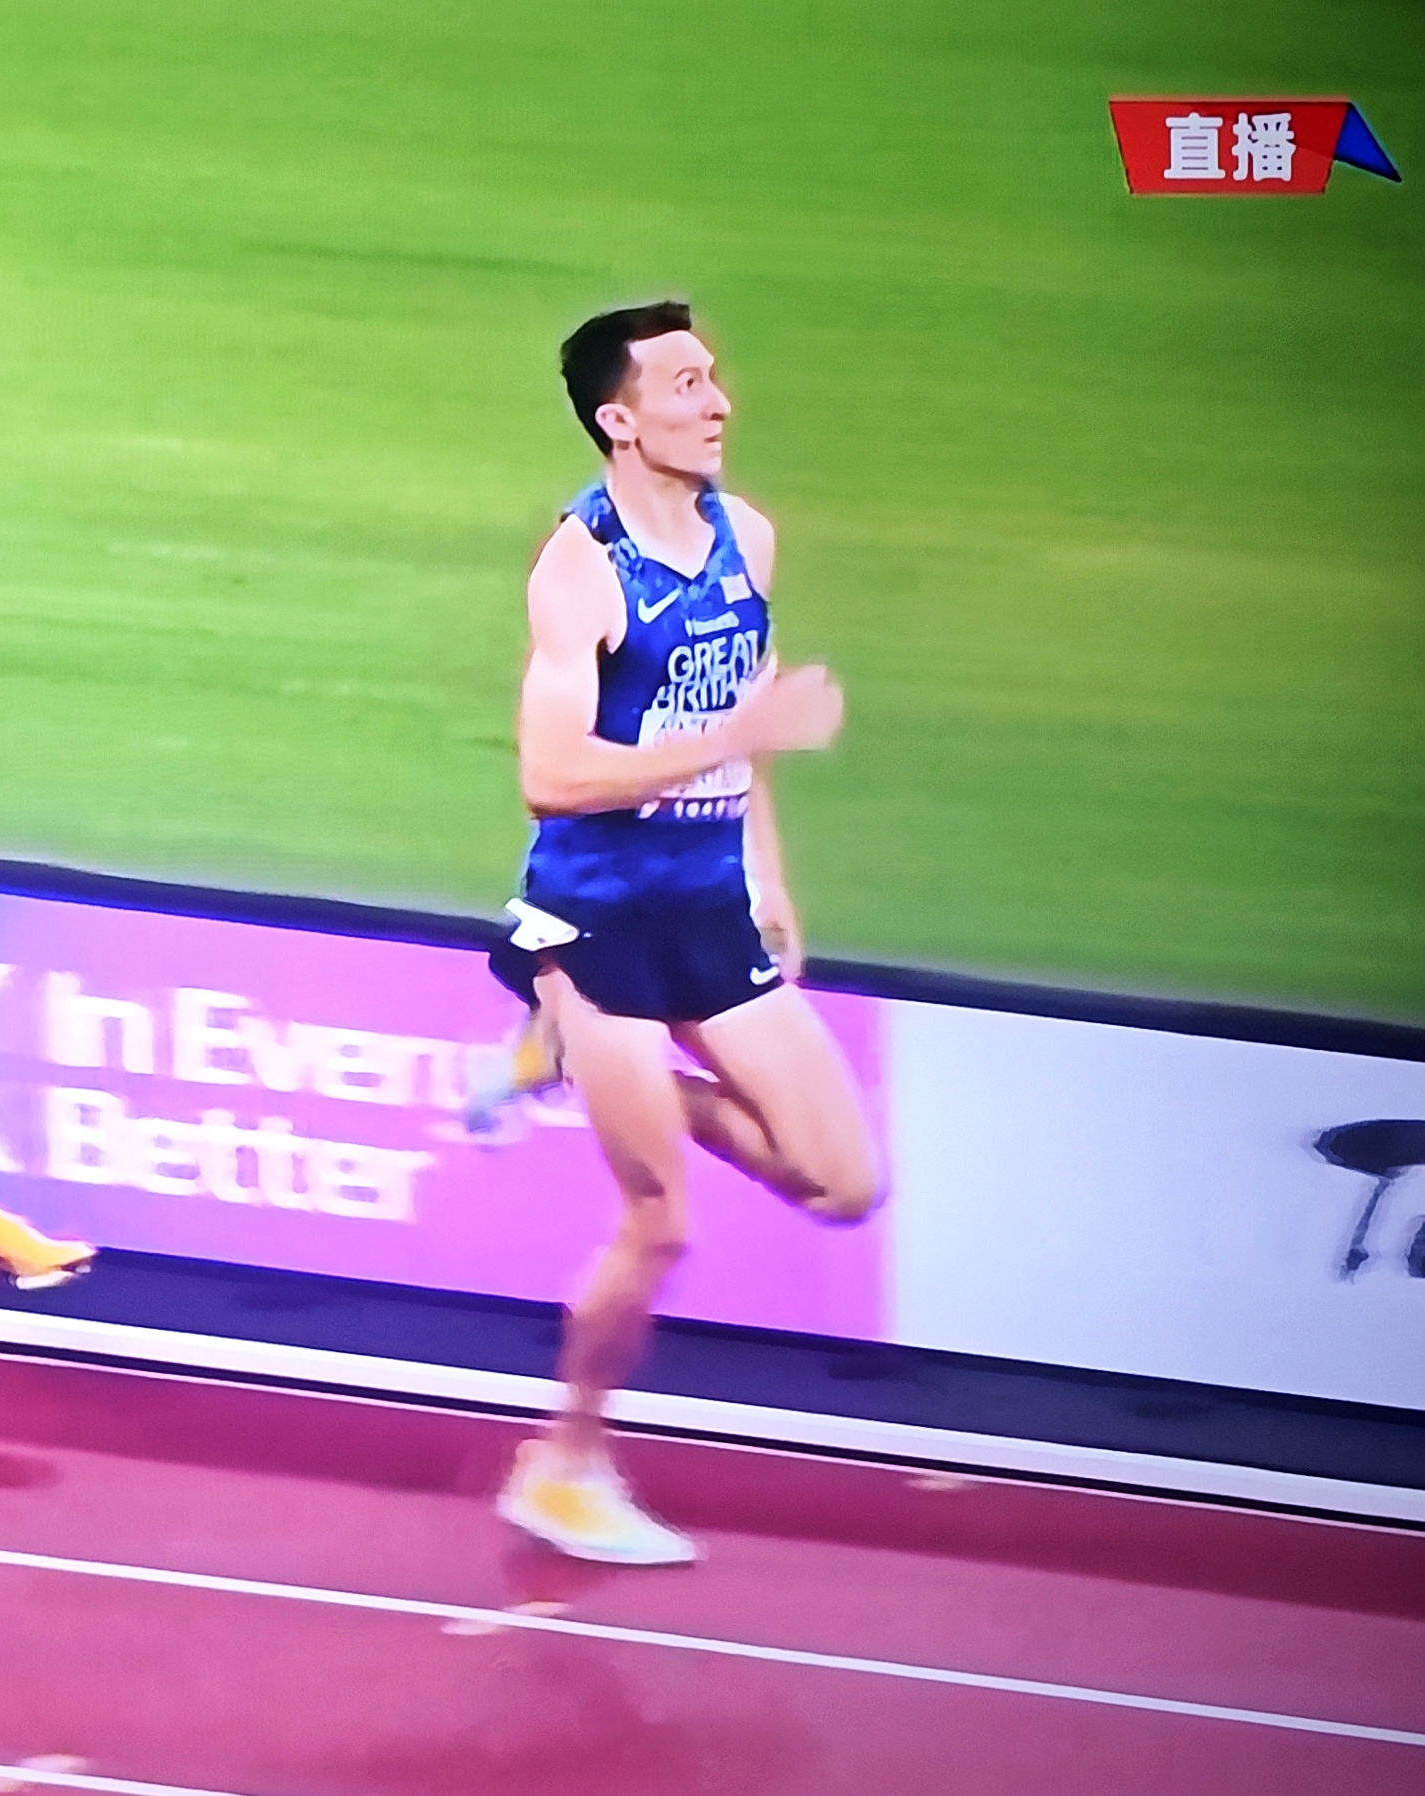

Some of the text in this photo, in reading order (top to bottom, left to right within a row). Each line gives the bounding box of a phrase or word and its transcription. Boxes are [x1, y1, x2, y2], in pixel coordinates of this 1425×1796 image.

[667, 629, 759, 685] GREAT
[43, 970, 158, 1076] In
[43, 1085, 437, 1225] Better
